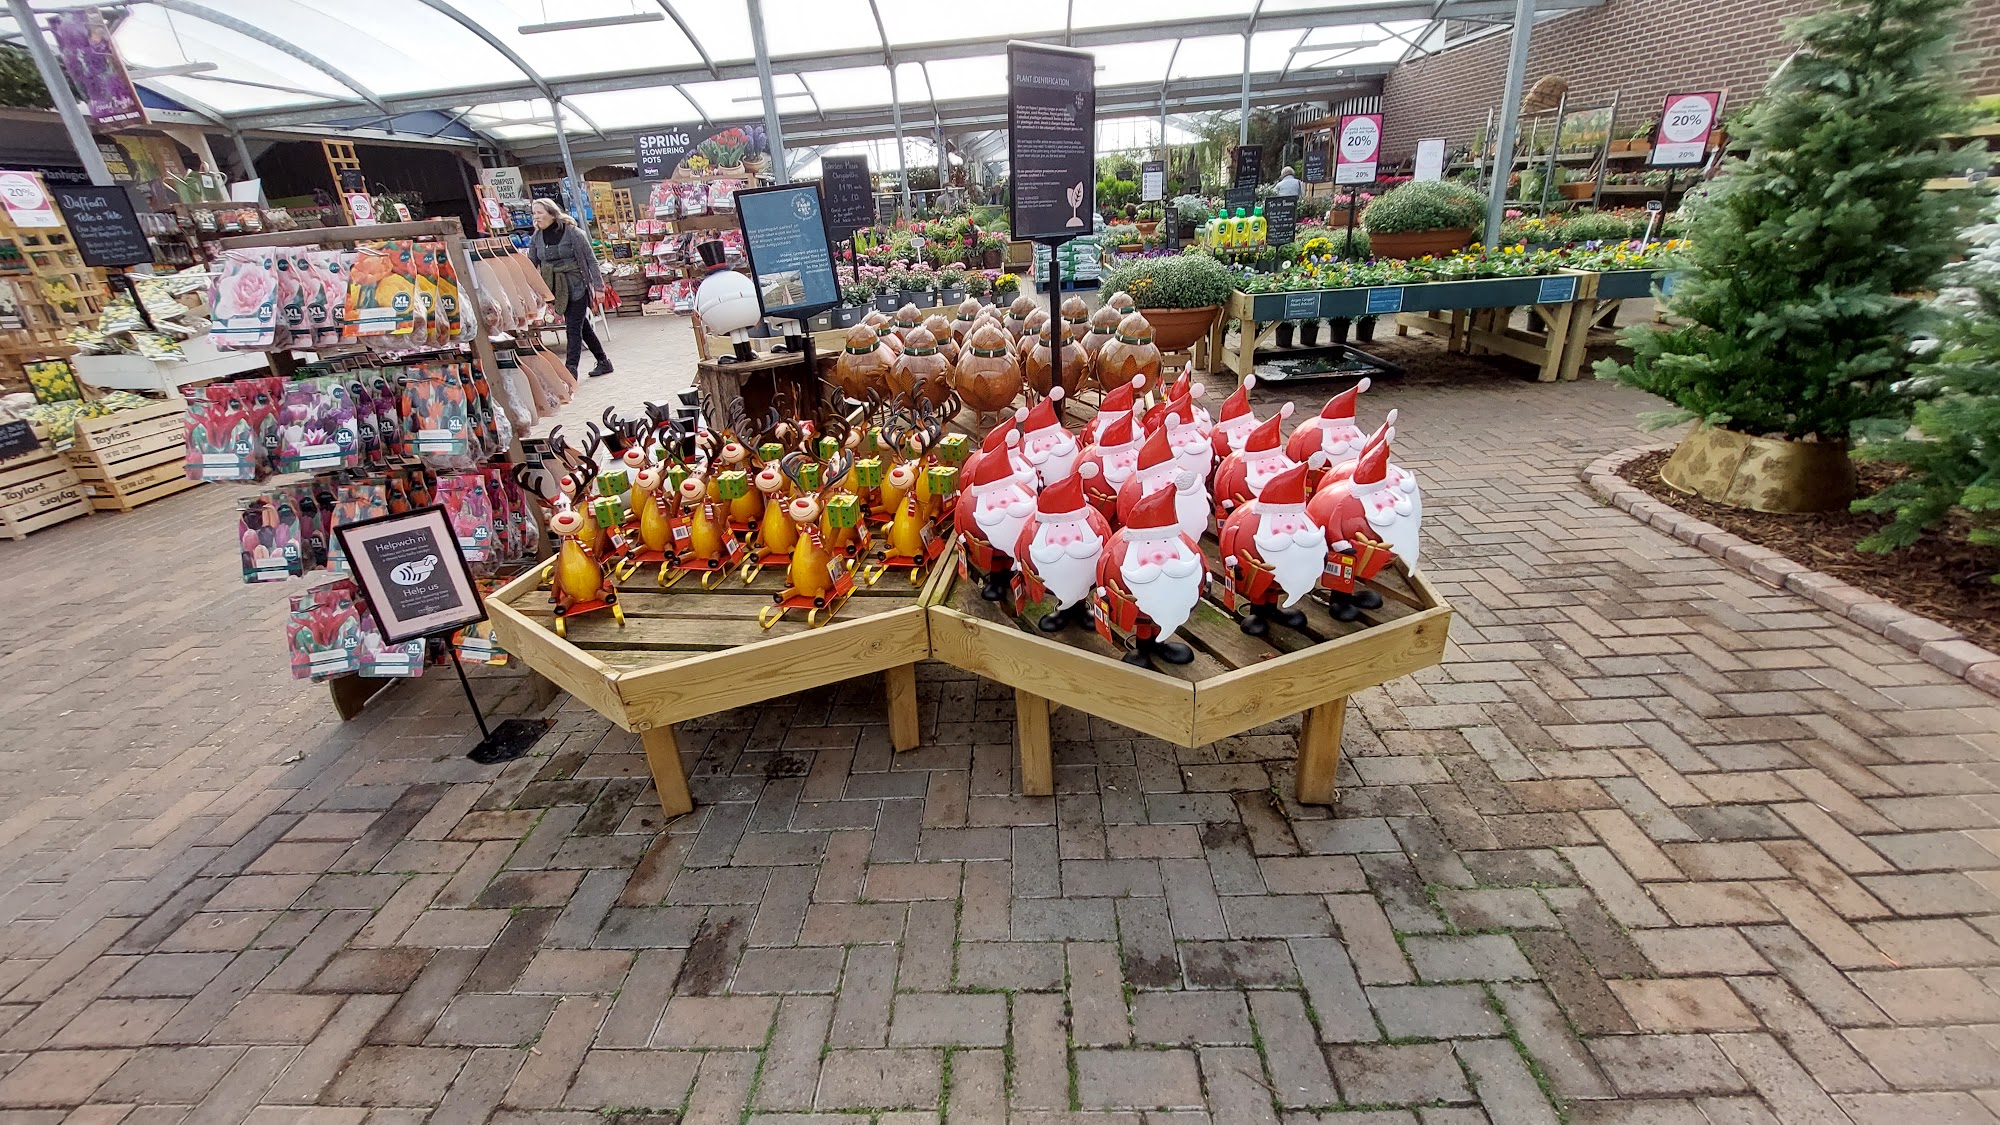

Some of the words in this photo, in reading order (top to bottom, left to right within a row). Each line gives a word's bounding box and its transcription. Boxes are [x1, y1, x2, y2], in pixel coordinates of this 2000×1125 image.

[1016, 74, 1032, 82] PLANT
[1033, 76, 1070, 86] IDENTIFICATION
[1672, 114, 1702, 126] 20%
[640, 133, 690, 148] SPRING
[1348, 135, 1372, 147] 20%
[641, 146, 684, 156] FLOWERING
[642, 156, 662, 164] POTS
[8, 188, 35, 197] 20%
[62, 194, 108, 210] Daffodil
[394, 296, 410, 304] XL
[285, 309, 301, 317] XL
[309, 308, 324, 316] XL
[92, 430, 131, 445] Taylors
[338, 432, 352, 440] XL
[2, 482, 46, 500] Taylors
[40, 490, 80, 506] Taylors
[375, 536, 416, 552] Helpwch
[418, 534, 427, 544] ni
[403, 586, 426, 597] Help
[428, 583, 439, 591] us
